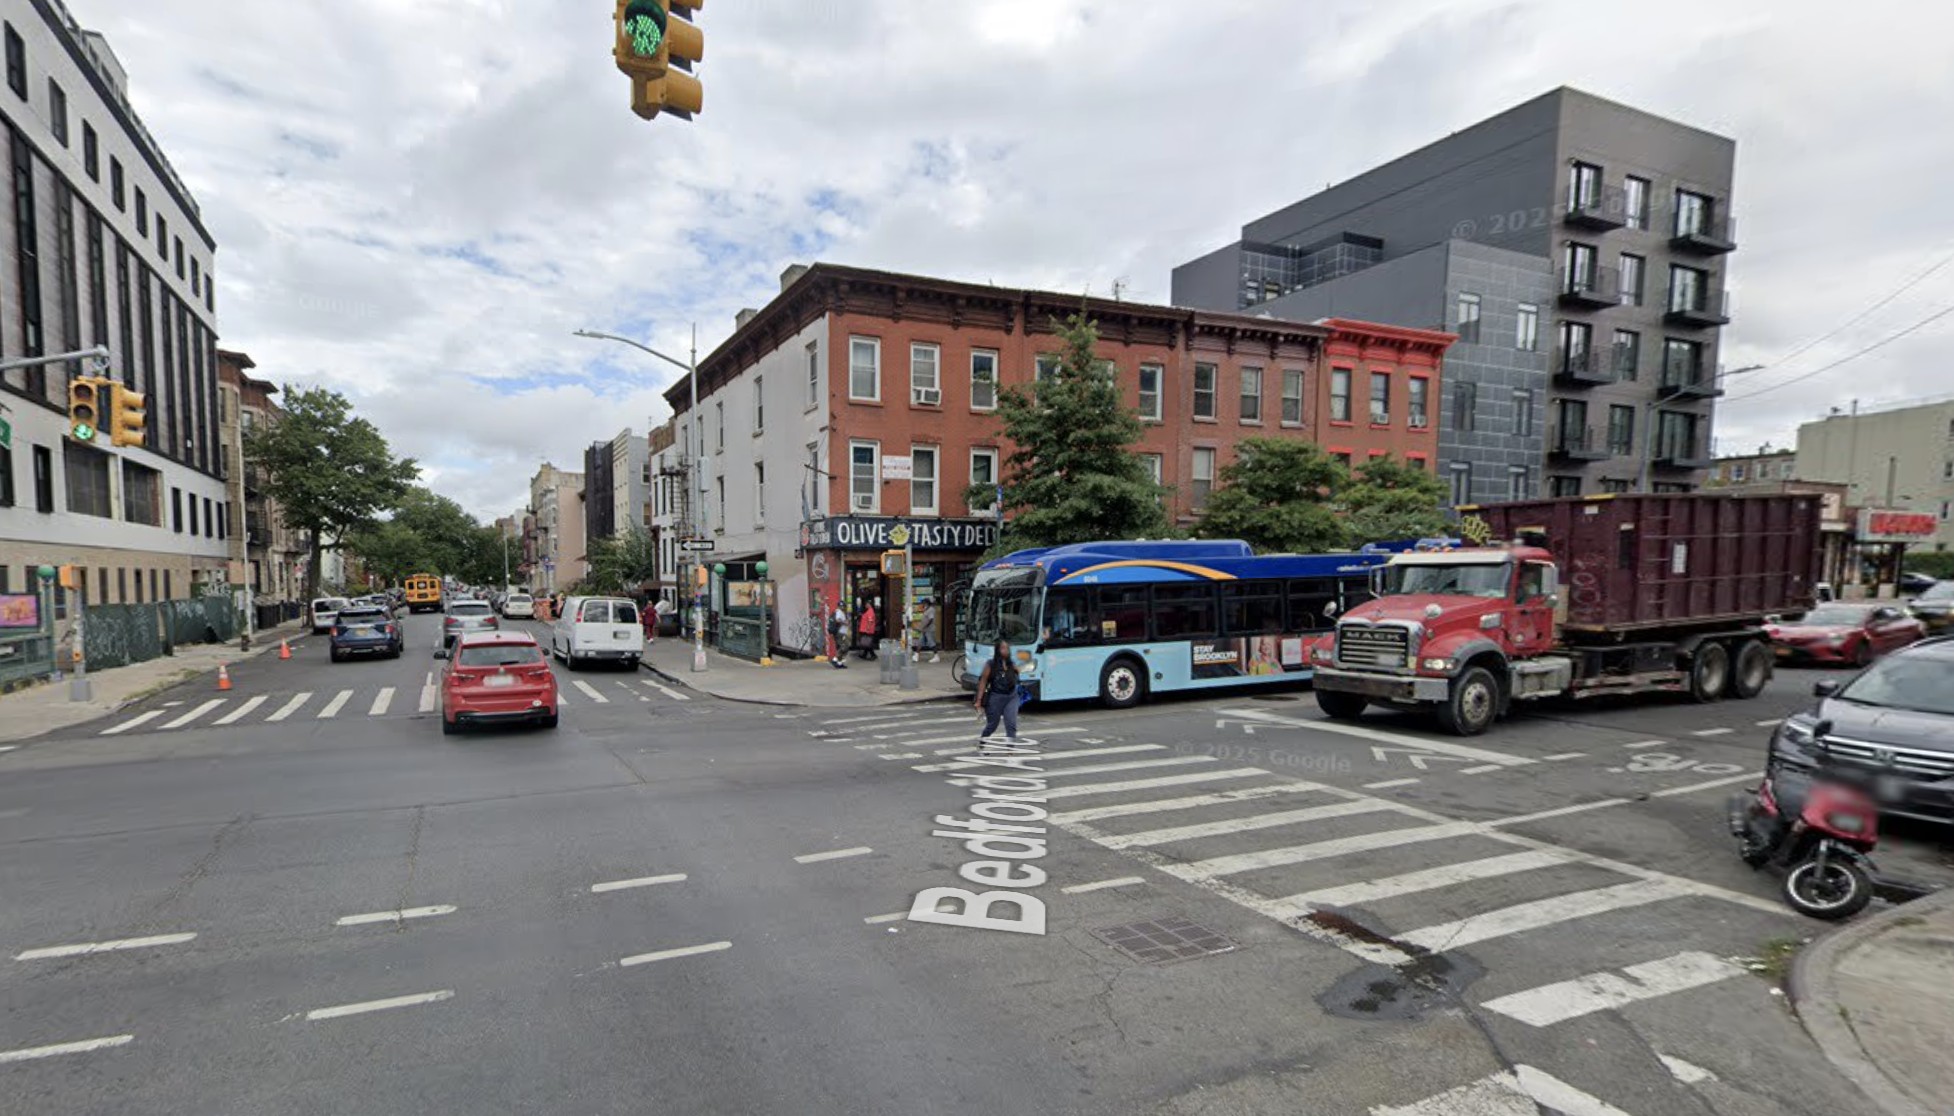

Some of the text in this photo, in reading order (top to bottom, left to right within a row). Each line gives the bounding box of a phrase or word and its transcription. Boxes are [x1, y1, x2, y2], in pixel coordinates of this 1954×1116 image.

[837, 521, 887, 545] OLIVE
[911, 522, 962, 546] TASTY
[1346, 631, 1401, 640] MACK
[1193, 644, 1214, 654] STAY
[1193, 651, 1238, 661] BROOKLYN
